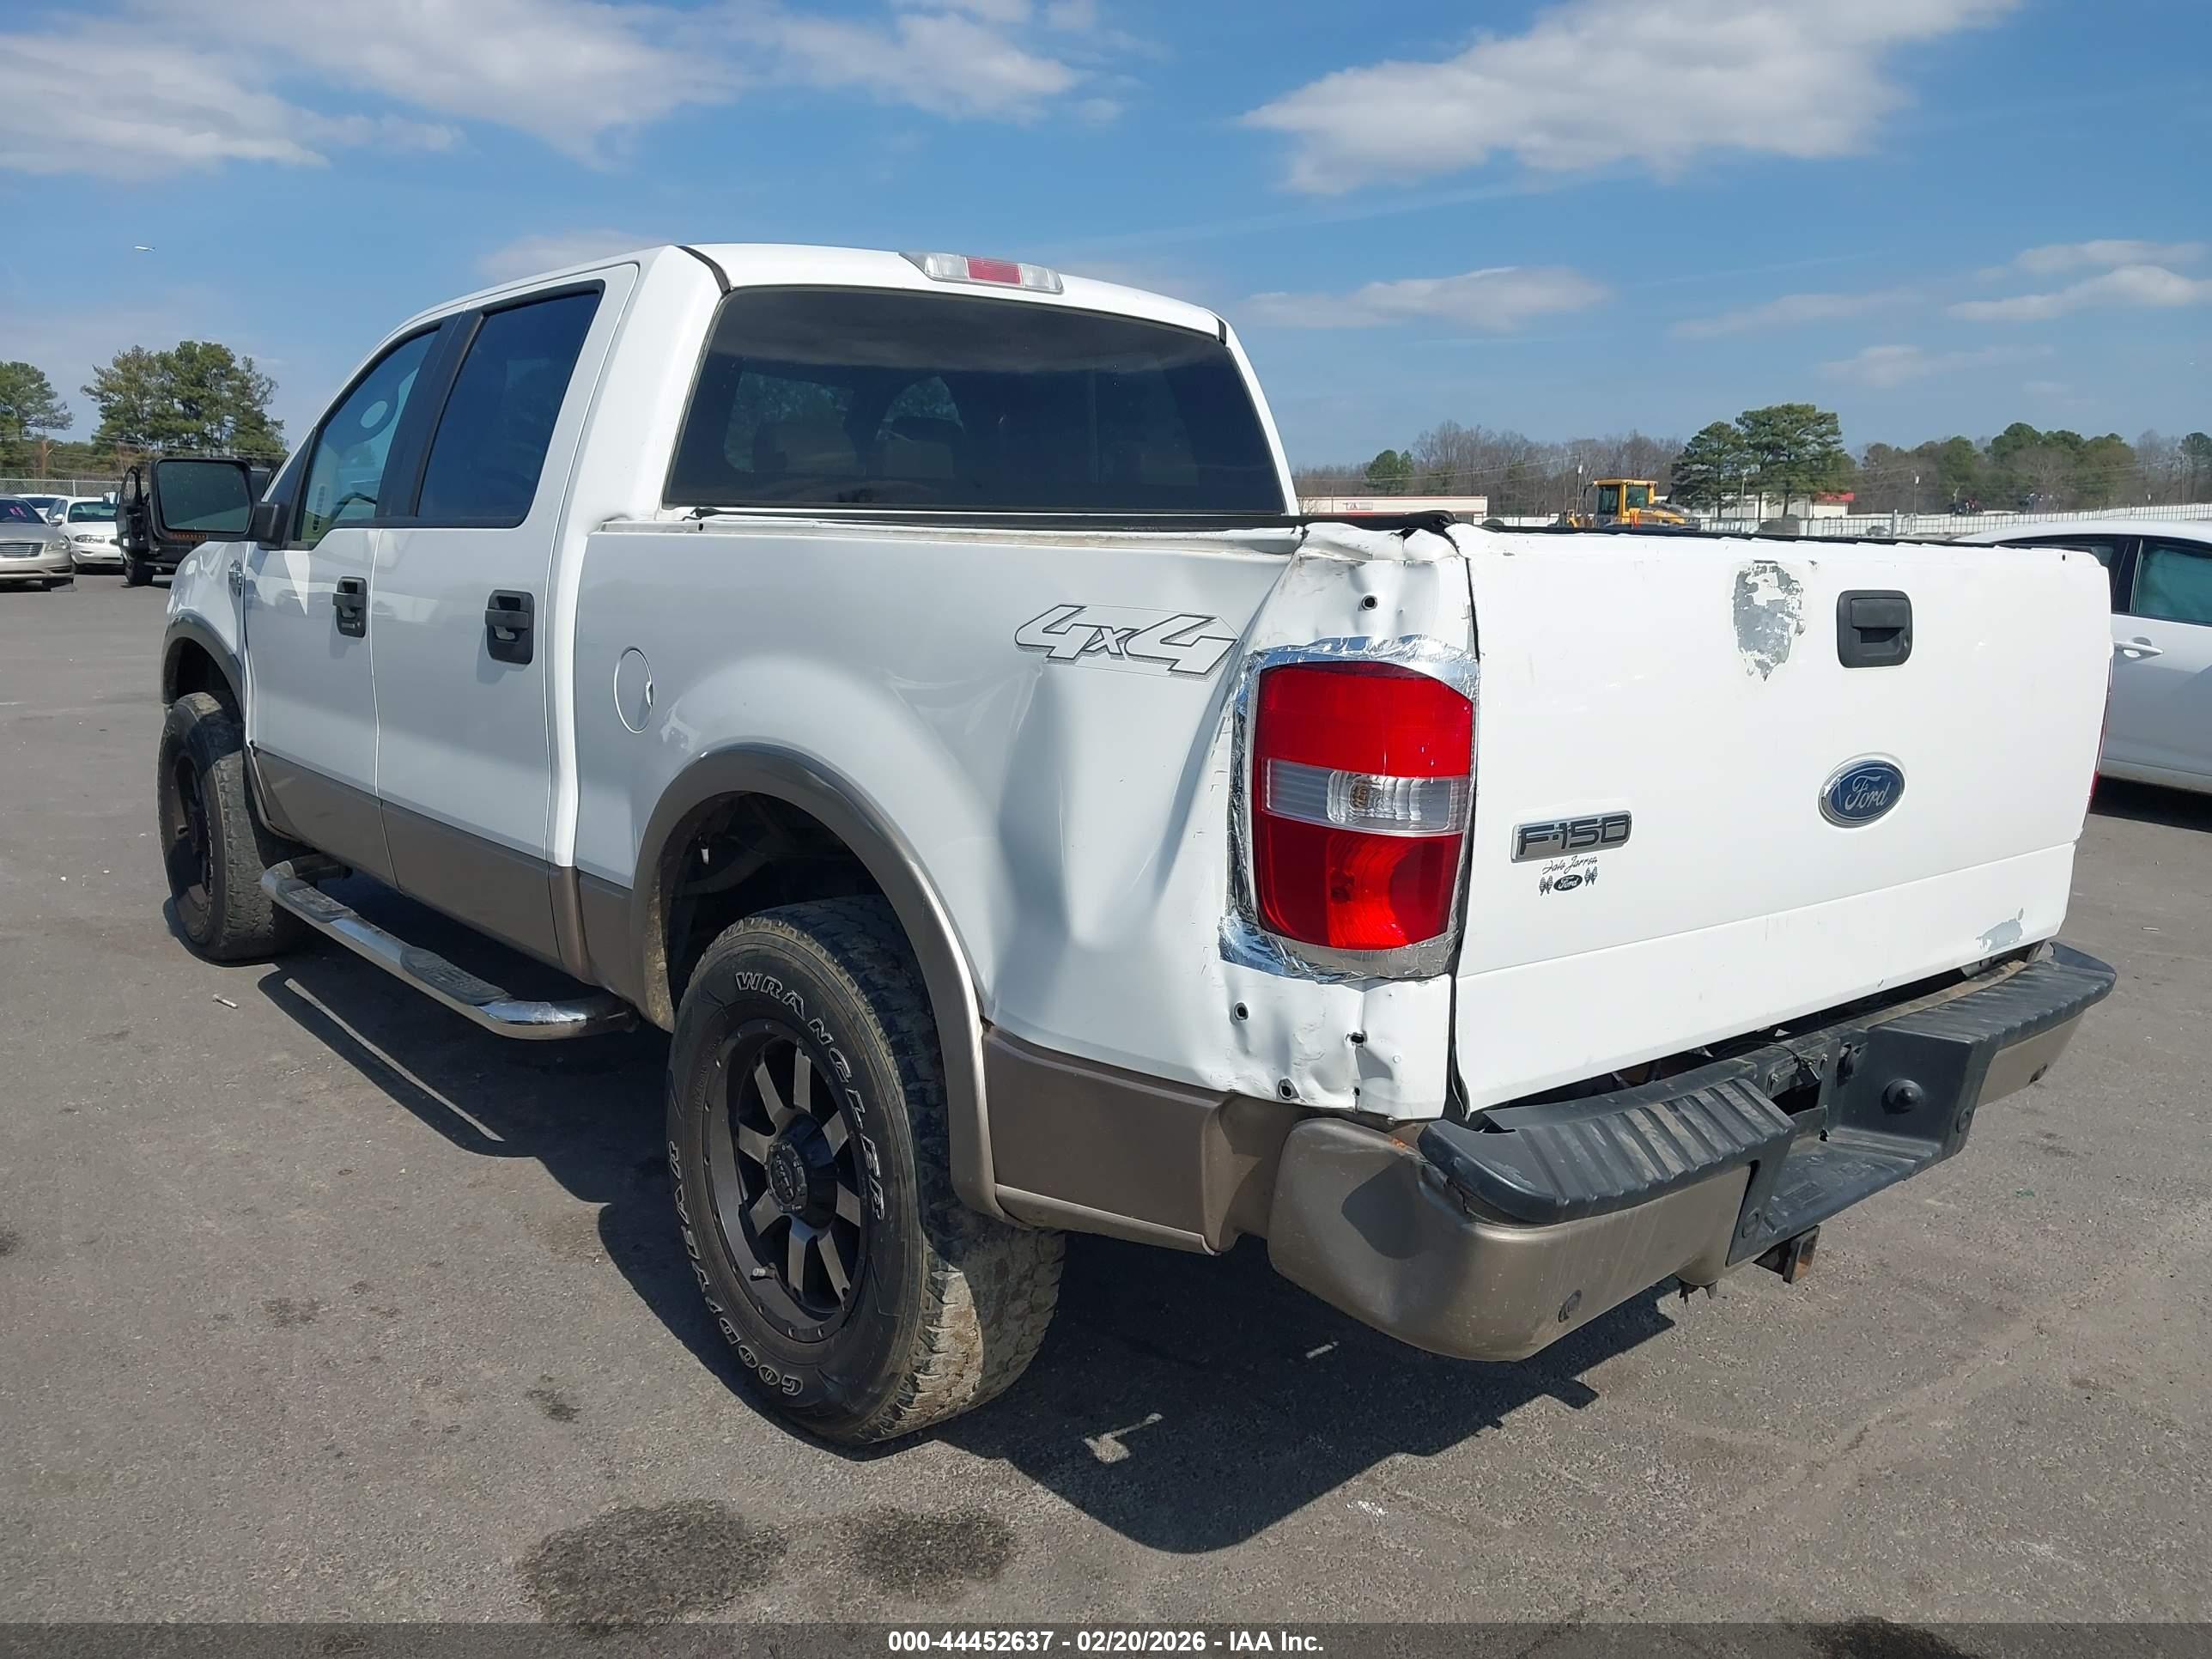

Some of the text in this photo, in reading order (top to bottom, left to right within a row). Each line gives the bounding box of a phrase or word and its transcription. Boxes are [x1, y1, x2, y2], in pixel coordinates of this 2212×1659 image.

[1517, 814, 1631, 856] F-150
[1844, 775, 1892, 811] Ford
[735, 971, 885, 1221] WRANGLER
[668, 1140, 804, 1396] GOODYEAR
